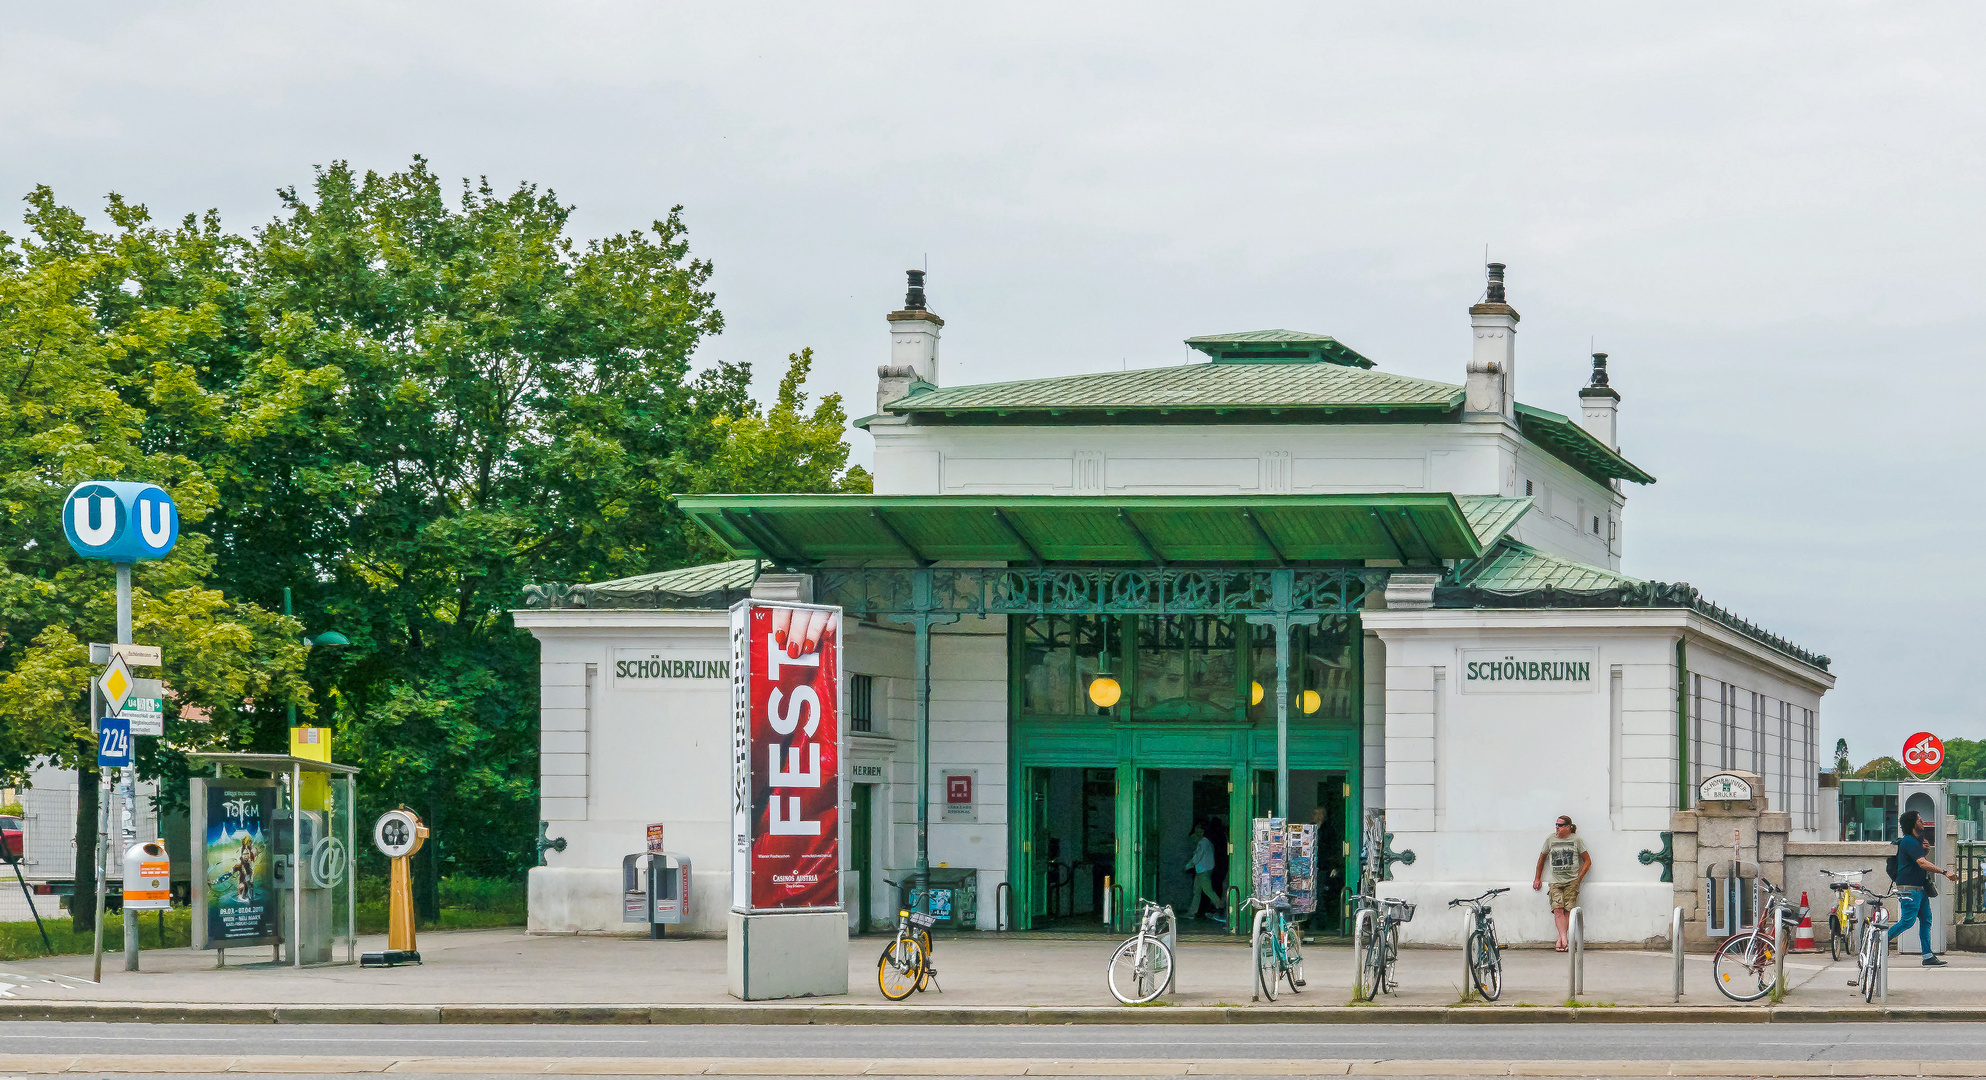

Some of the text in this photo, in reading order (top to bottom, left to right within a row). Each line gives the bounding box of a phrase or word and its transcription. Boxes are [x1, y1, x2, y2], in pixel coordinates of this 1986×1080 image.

[73, 497, 116, 547] U
[140, 499, 170, 548] U
[616, 654, 730, 679] SCHÖNBRUNN
[1467, 656, 1590, 681] SCHÖNBRUNN
[101, 728, 128, 757] 224
[768, 632, 821, 835] FEST
[852, 765, 882, 777] HERREN
[222, 798, 260, 828] TOTEM
